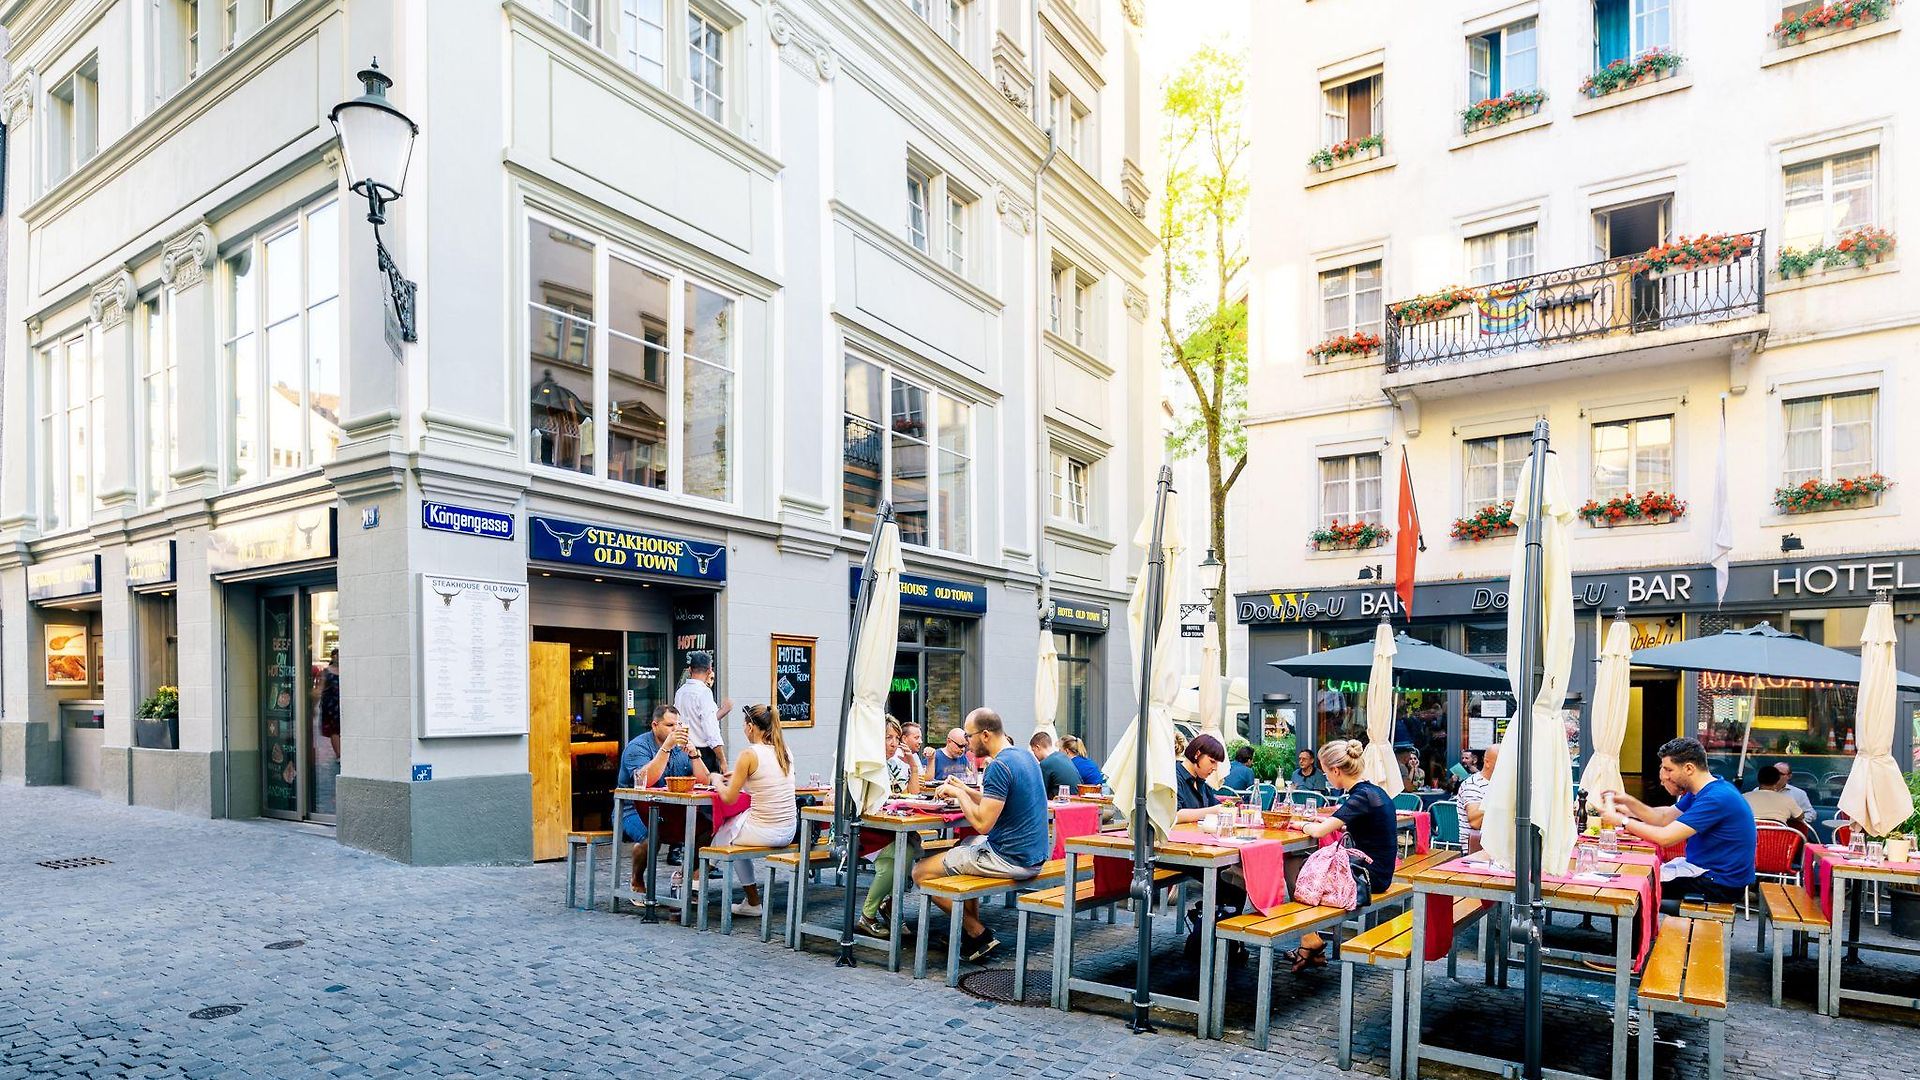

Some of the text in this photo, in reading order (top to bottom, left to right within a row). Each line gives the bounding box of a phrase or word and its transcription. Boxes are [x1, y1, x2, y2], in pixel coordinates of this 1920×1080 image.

[429, 504, 509, 533] Köngengasse
[587, 528, 684, 557] STEAKHOUSE
[594, 547, 678, 572] OLD TOWN
[432, 579, 520, 594] STEAKHOUSE OLD TOWN
[1628, 573, 1692, 602] BAR
[1773, 561, 1920, 596] HOTEL
[935, 586, 951, 599] OLD
[951, 589, 974, 603] TOWN
[674, 608, 705, 620] Welcome
[1057, 606, 1073, 618] HOTEL
[1075, 609, 1086, 619] OLD
[1239, 596, 1346, 621] Double-U
[778, 646, 807, 663] HOTEL
[796, 673, 810, 682] ROOM
